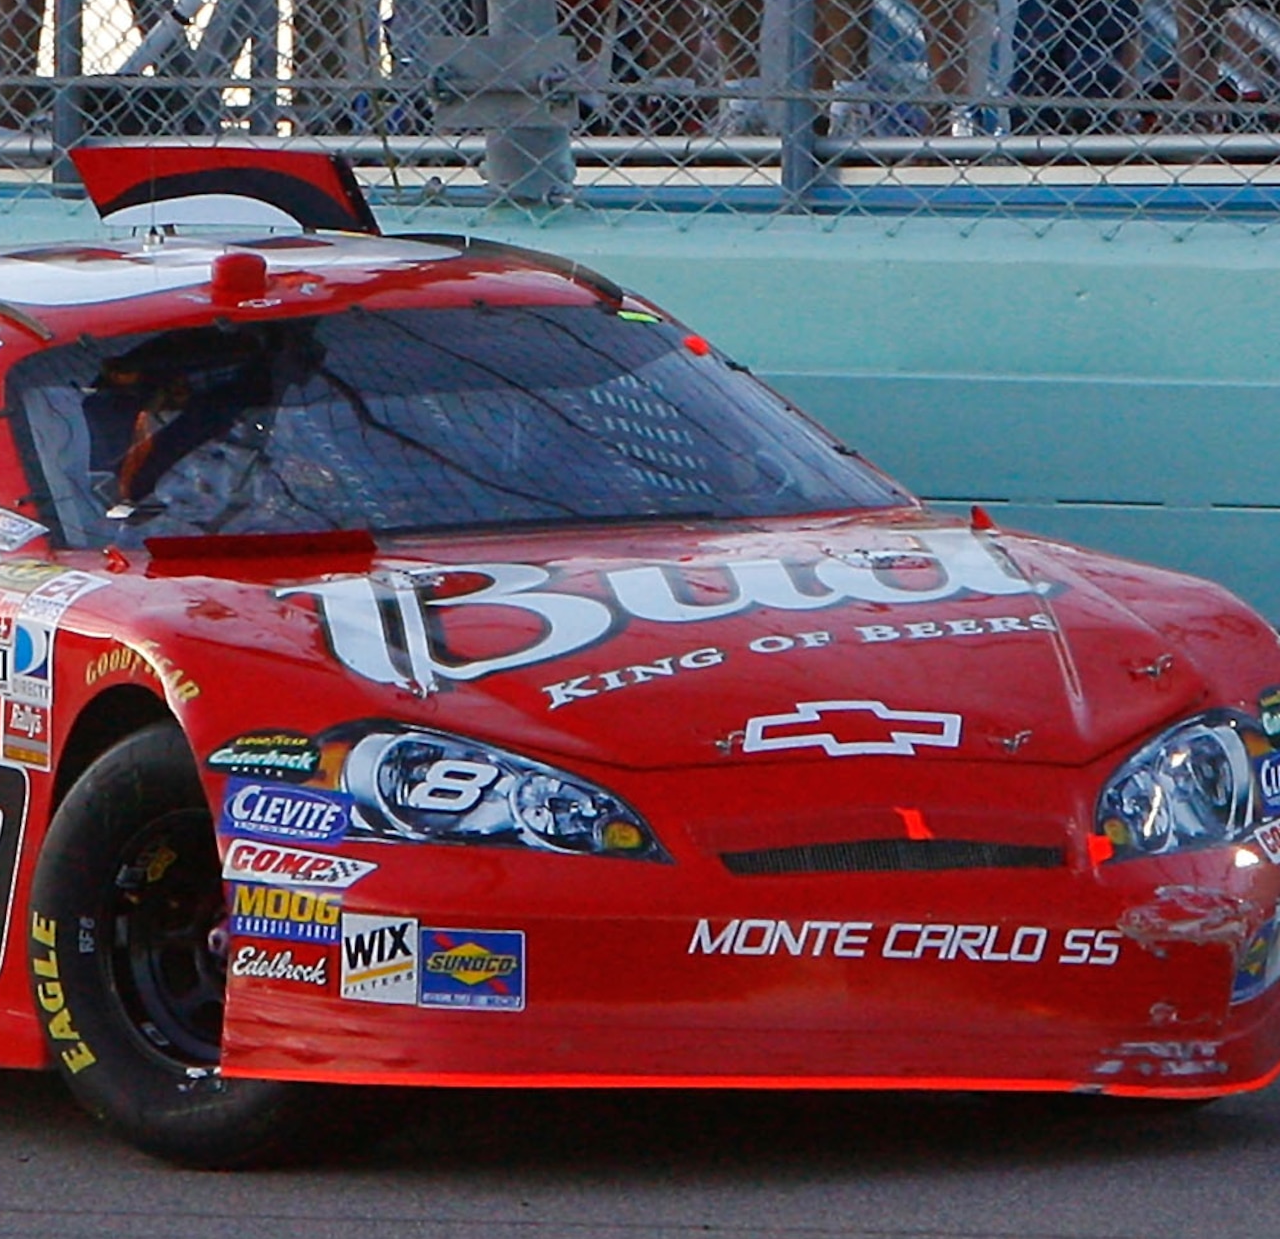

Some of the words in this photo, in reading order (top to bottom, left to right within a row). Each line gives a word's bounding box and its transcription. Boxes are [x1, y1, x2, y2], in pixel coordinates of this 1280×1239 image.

[275, 528, 1052, 698] Bud
[541, 646, 724, 711] KING
[749, 630, 830, 654] OF
[854, 613, 1056, 643] BEERS
[231, 784, 342, 832] CLEVITE
[409, 759, 503, 812] 8
[230, 844, 334, 876] COMP
[232, 885, 343, 926] MOOG
[232, 946, 327, 985] Edelbrock
[344, 921, 413, 970] WIX
[429, 953, 516, 973] SUNOCO
[687, 918, 873, 957] MONTE
[881, 922, 1047, 963] CARLO
[1058, 929, 1122, 966] SS
[32, 911, 97, 1075] EAGLE
[343, 971, 414, 996] FILTERS
